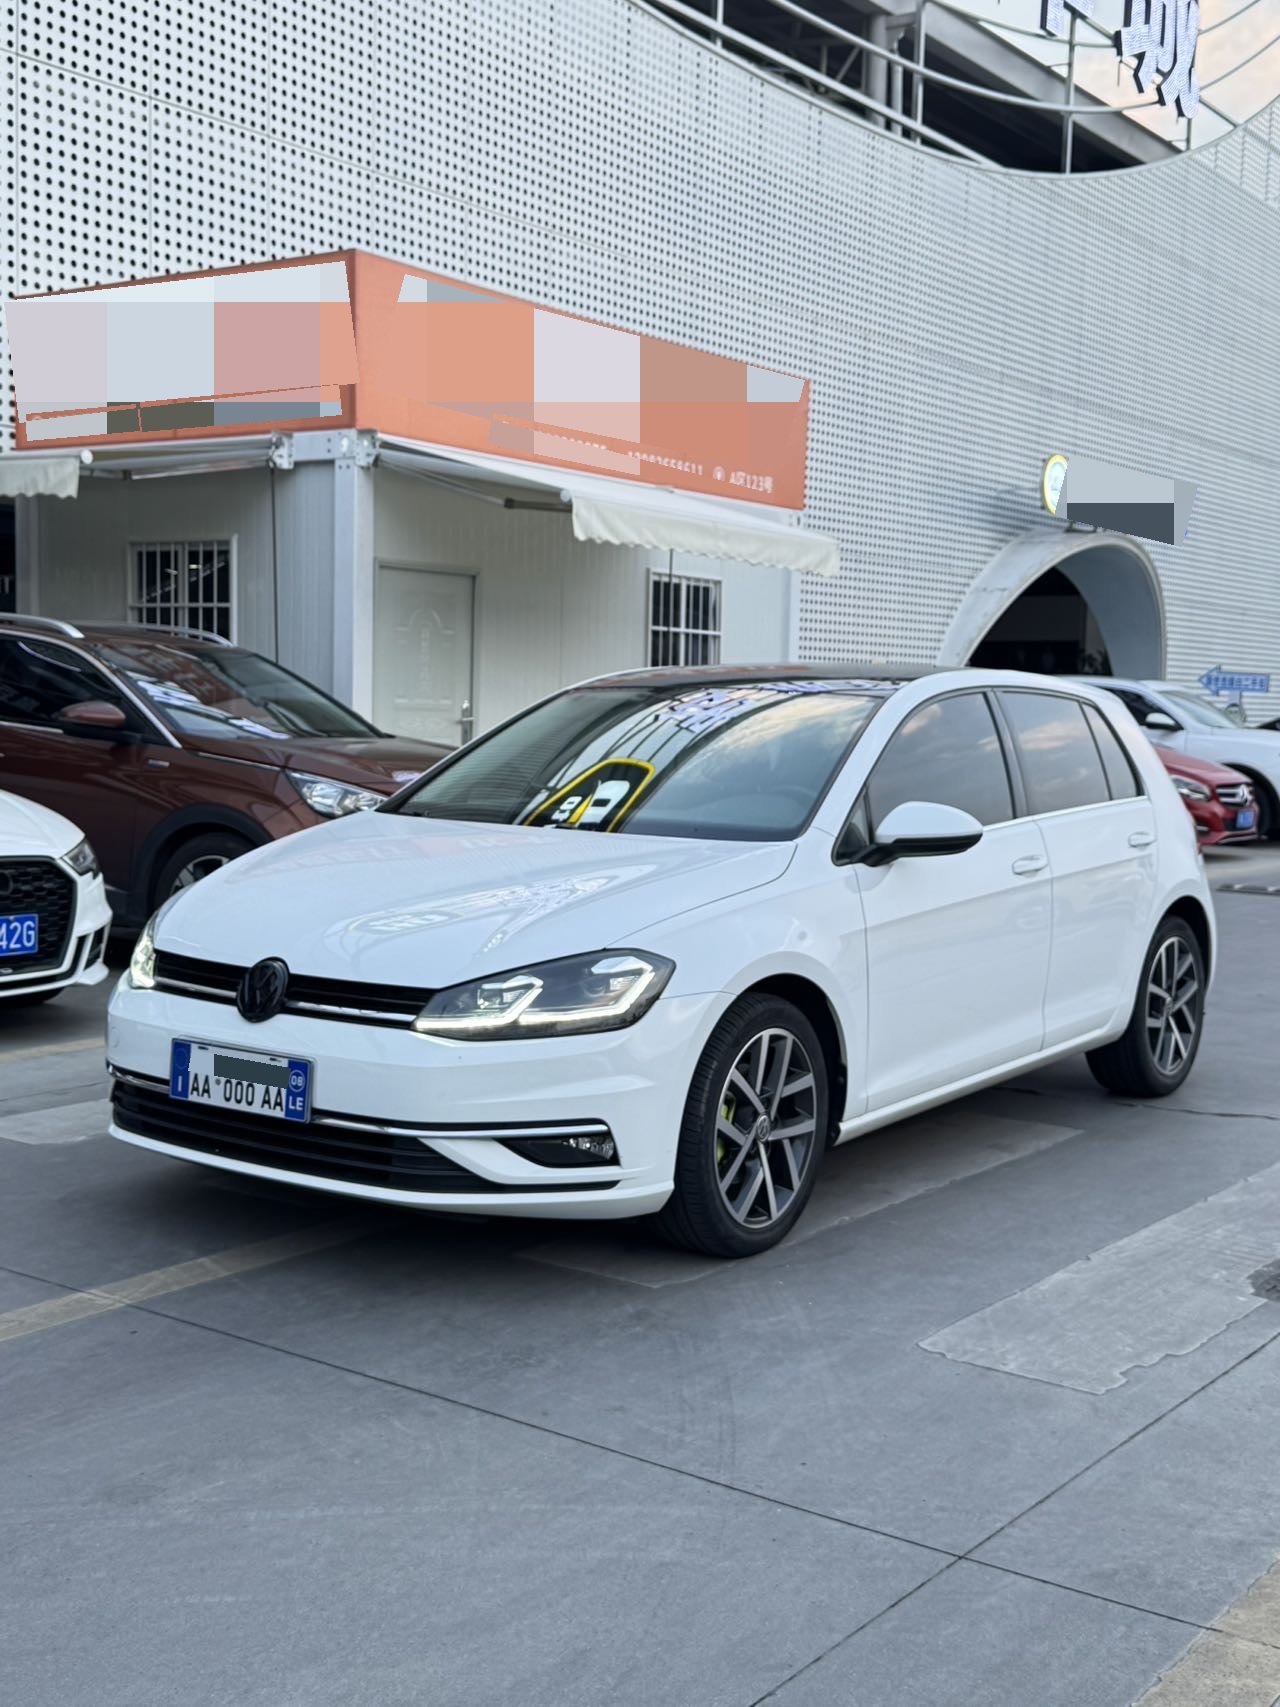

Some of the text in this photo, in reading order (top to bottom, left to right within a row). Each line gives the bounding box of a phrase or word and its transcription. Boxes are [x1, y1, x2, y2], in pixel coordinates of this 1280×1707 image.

[190, 1072, 211, 1099] AA
[261, 1085, 284, 1112] AA
[288, 1096, 304, 1111] LE
